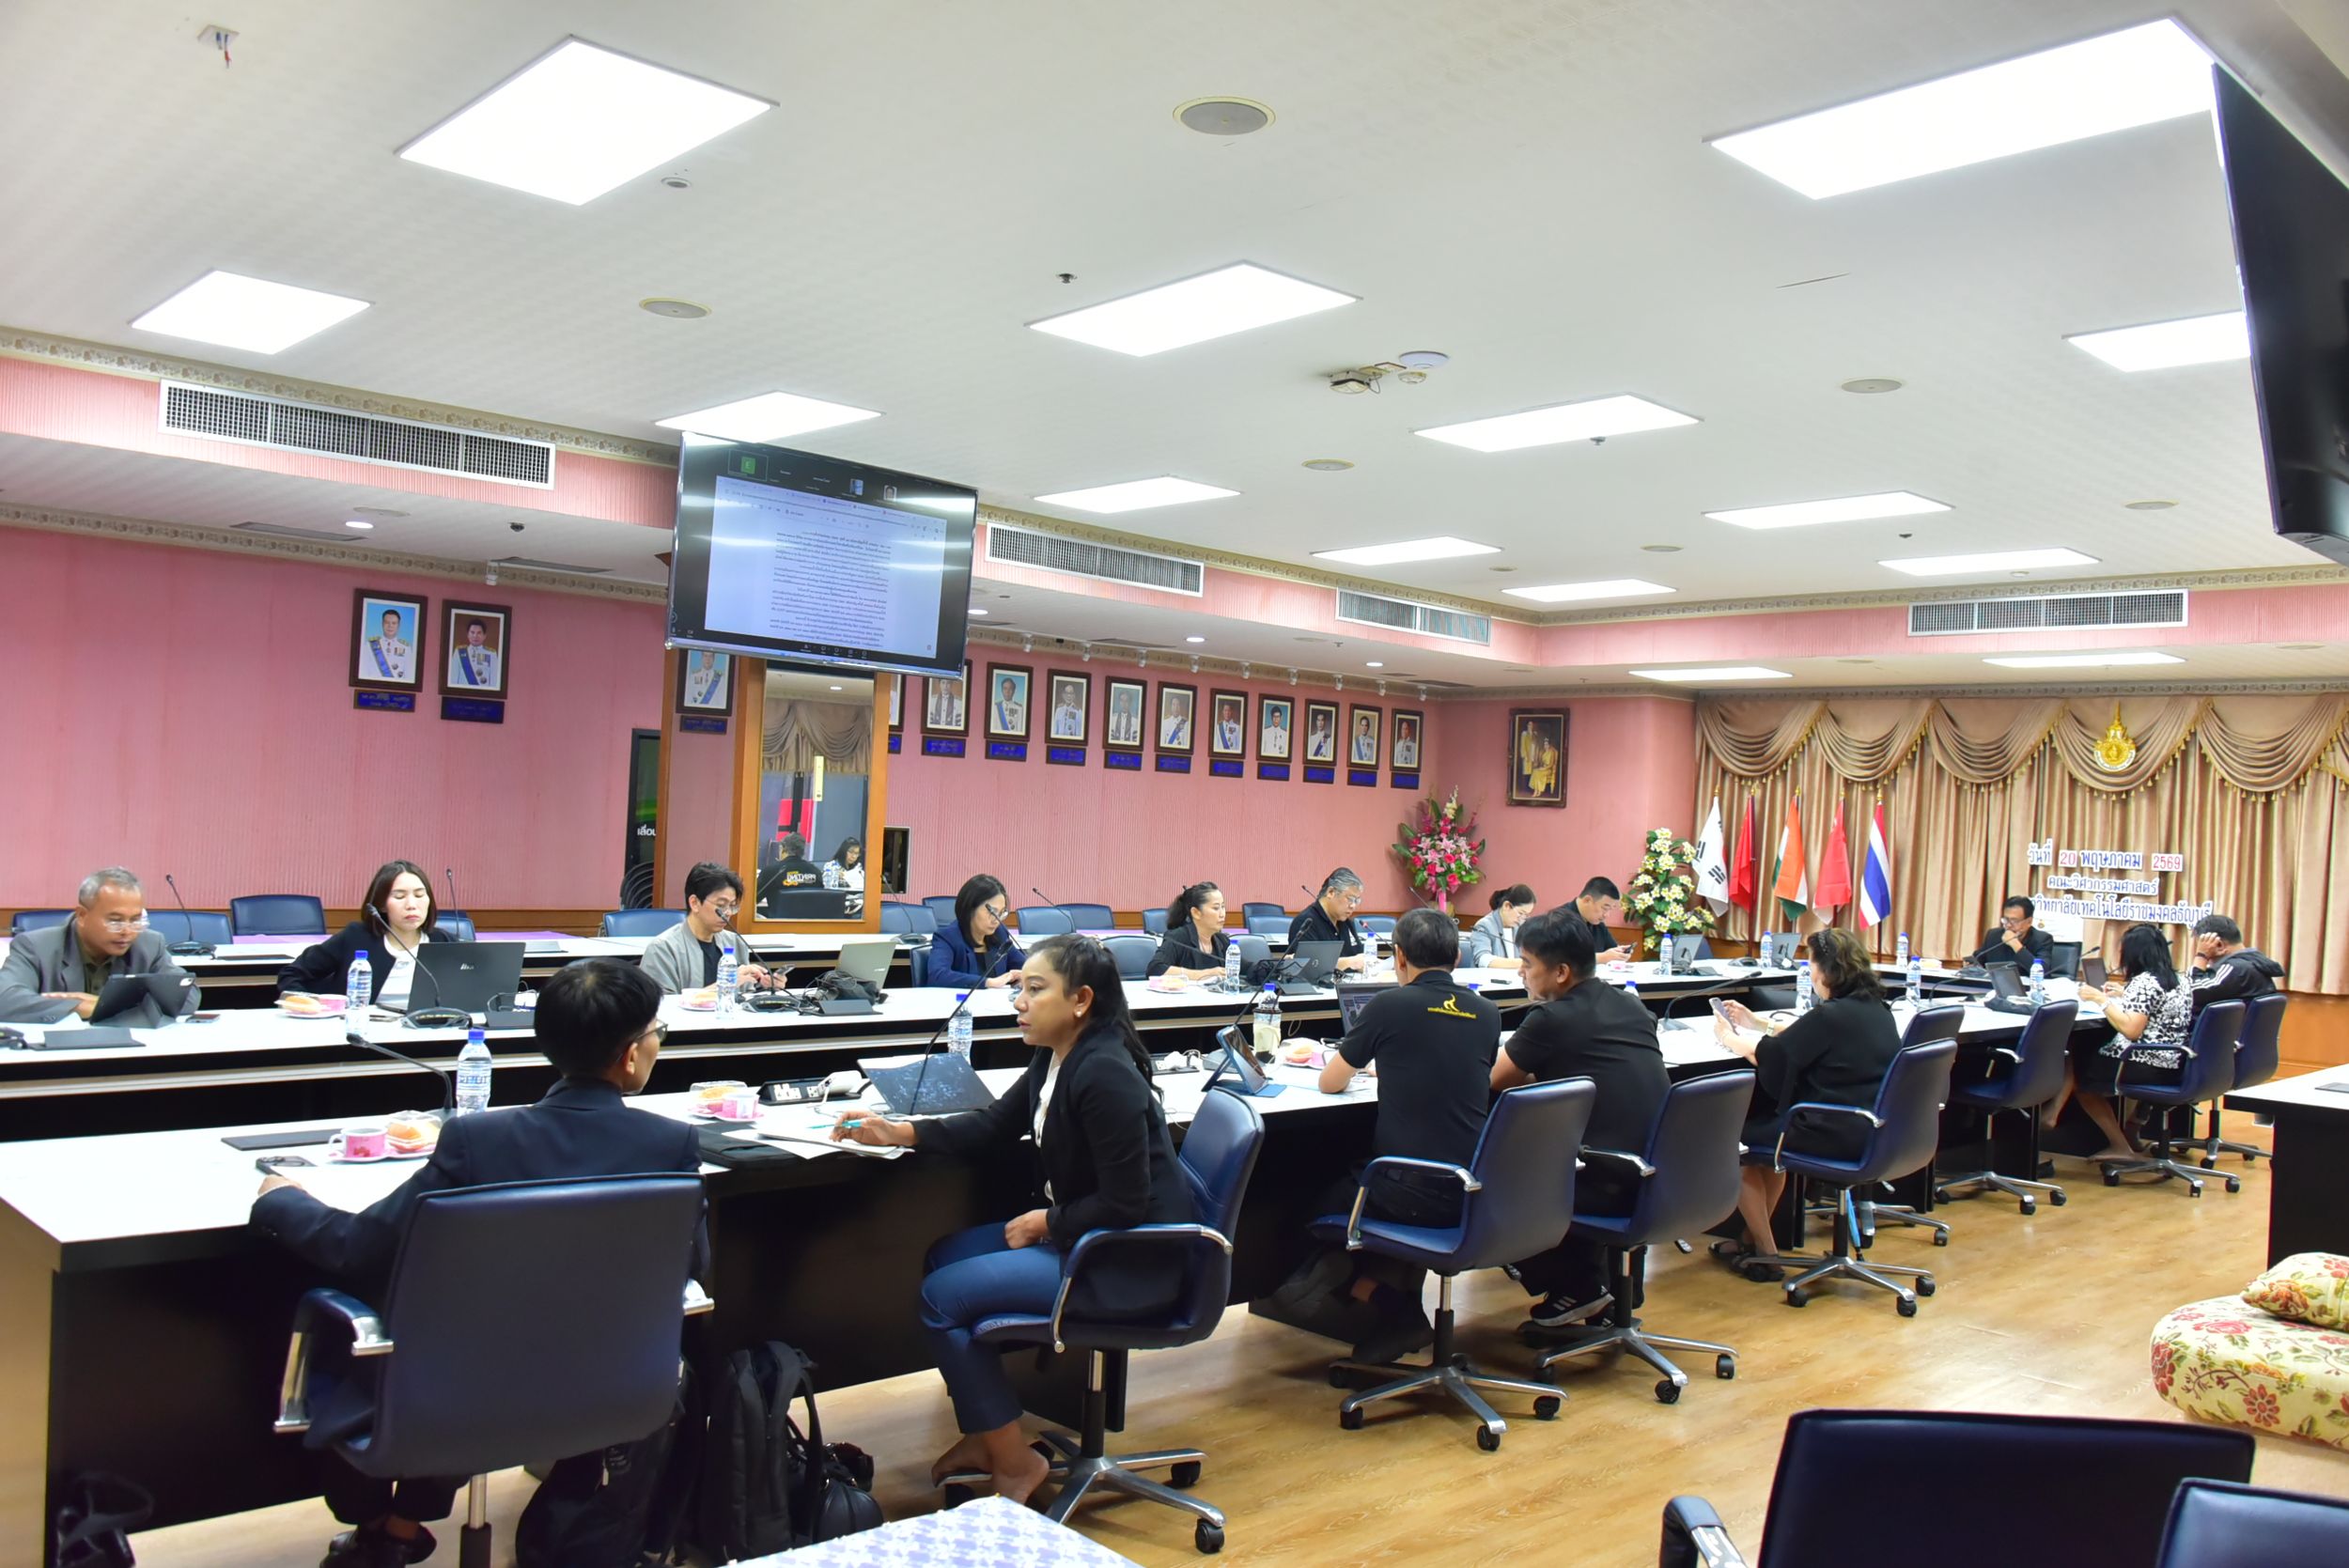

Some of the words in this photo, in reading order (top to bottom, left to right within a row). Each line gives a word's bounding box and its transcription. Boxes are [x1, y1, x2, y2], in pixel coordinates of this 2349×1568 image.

[2029, 840, 2051, 863] วันที่
[2060, 851, 2077, 865] 20
[2081, 851, 2140, 871] พฤษภาคม
[2153, 855, 2181, 870] 2569
[2048, 874, 2158, 894] คณะวิศวกรรมศาสตร์
